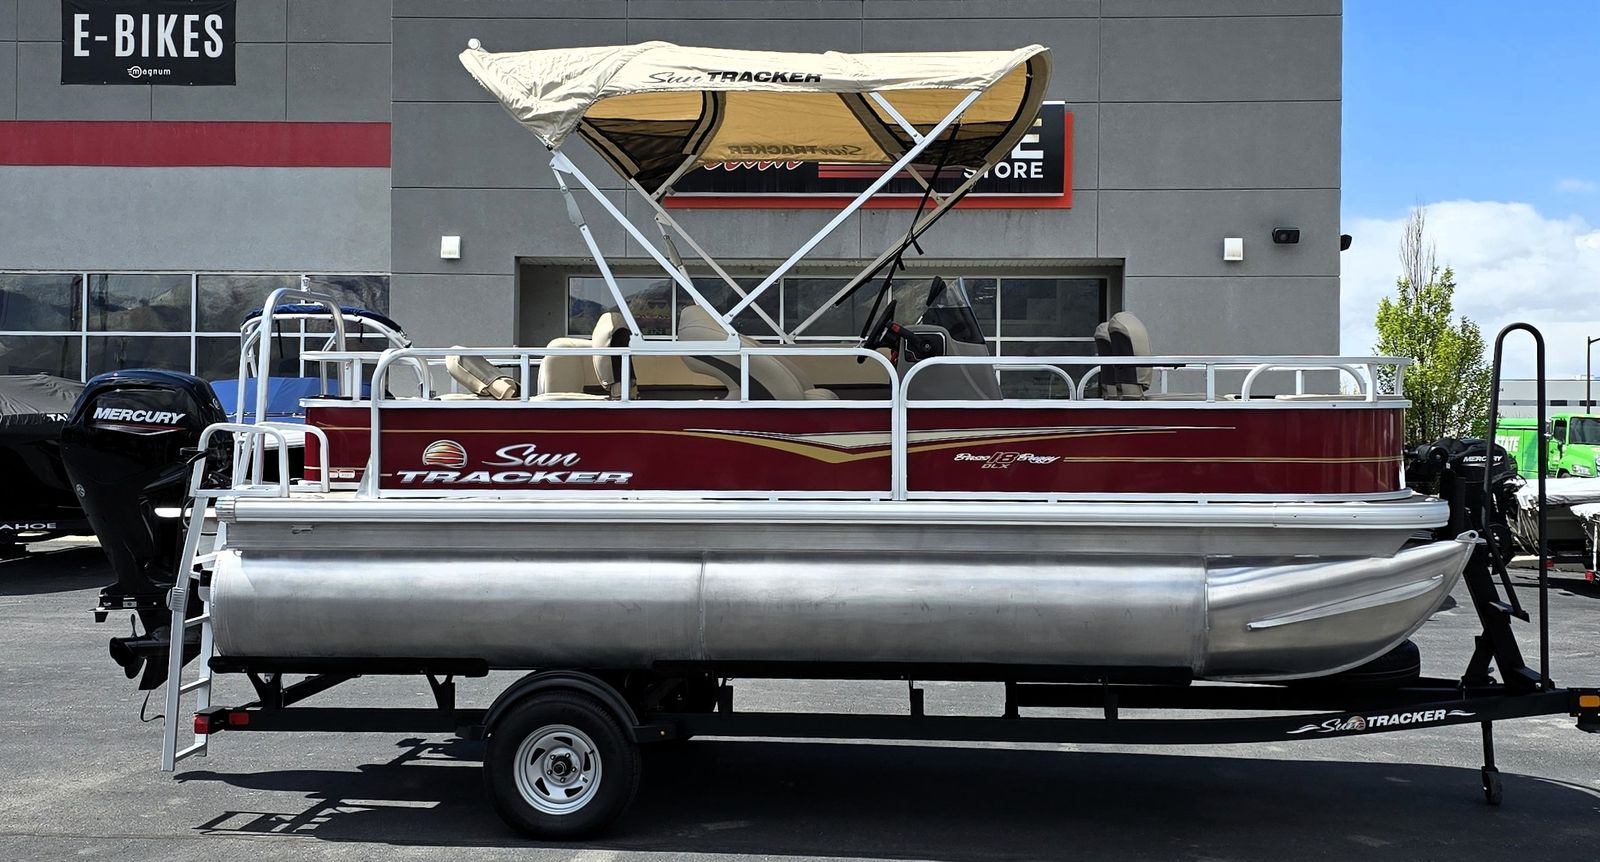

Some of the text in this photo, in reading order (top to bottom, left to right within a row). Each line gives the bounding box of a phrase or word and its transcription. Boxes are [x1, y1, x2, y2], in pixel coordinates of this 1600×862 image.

[73, 13, 224, 58] E-BIKES
[644, 71, 823, 84] Sun TRACKER
[93, 407, 186, 424] MERCURY
[481, 443, 581, 468] Sun
[986, 451, 1020, 464] 18
[1463, 455, 1502, 463] MERCRY
[397, 471, 633, 485] TRACKER
[1317, 709, 1446, 733] Sun TRACKER
